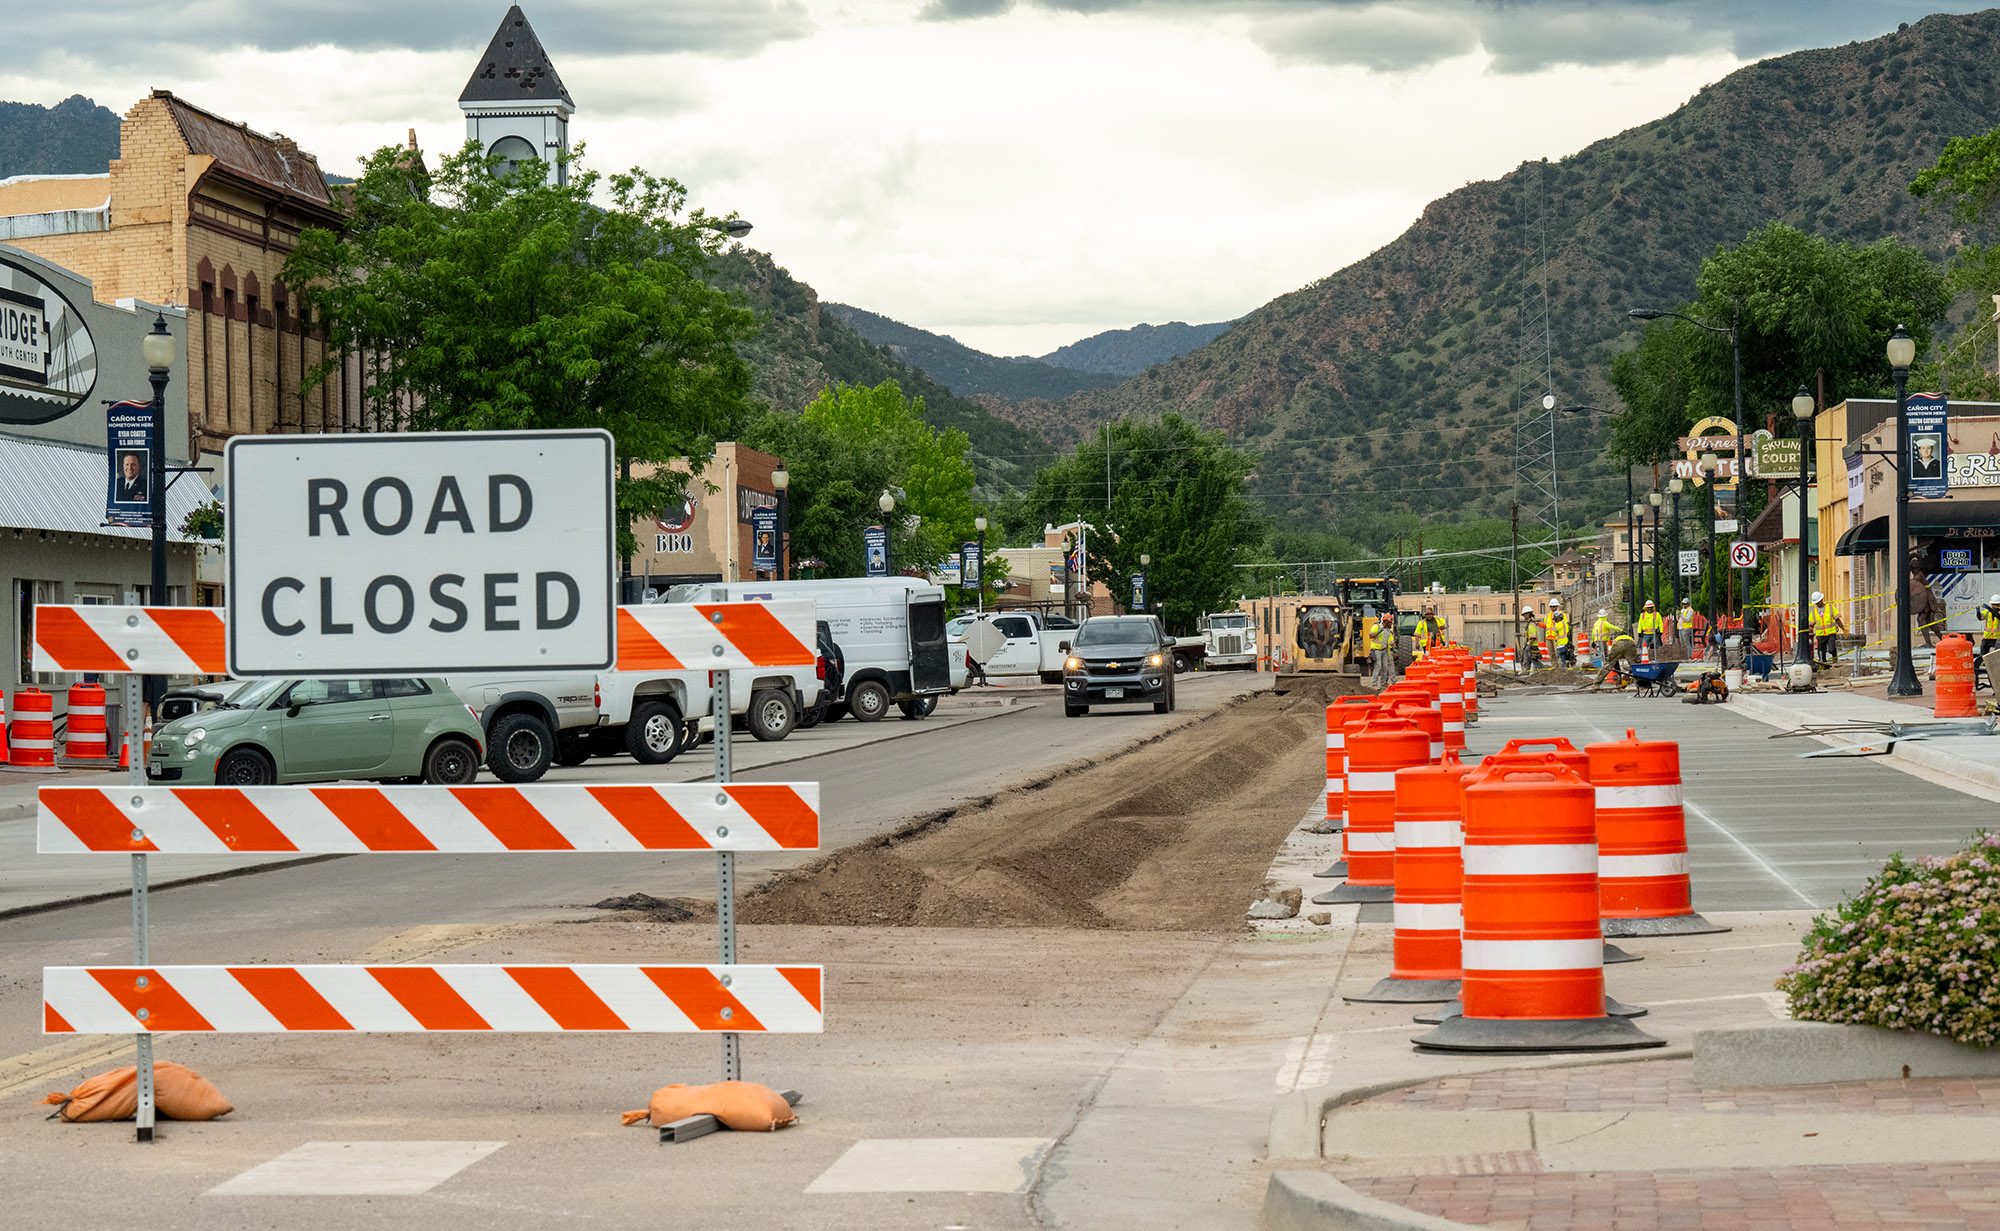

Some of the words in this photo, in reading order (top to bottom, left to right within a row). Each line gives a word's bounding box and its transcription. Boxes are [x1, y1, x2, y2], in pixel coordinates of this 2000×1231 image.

[15, 348, 38, 364] CENTER
[110, 414, 136, 422] CAÑON
[1686, 437, 1748, 451] Pionee
[1772, 465, 1801, 473] VACAN
[1947, 456, 1957, 473] i
[1960, 454, 2000, 477] Ri
[308, 474, 533, 537] ROAD
[1945, 527, 1960, 537] Di
[1963, 527, 1995, 537] Rito's
[655, 533, 693, 554] BBQ
[1946, 551, 1967, 559] BUD
[1943, 558, 1969, 566] LIGHT
[1681, 563, 1698, 573] 25
[261, 571, 580, 637] CLOSED
[557, 695, 578, 704] TRD
